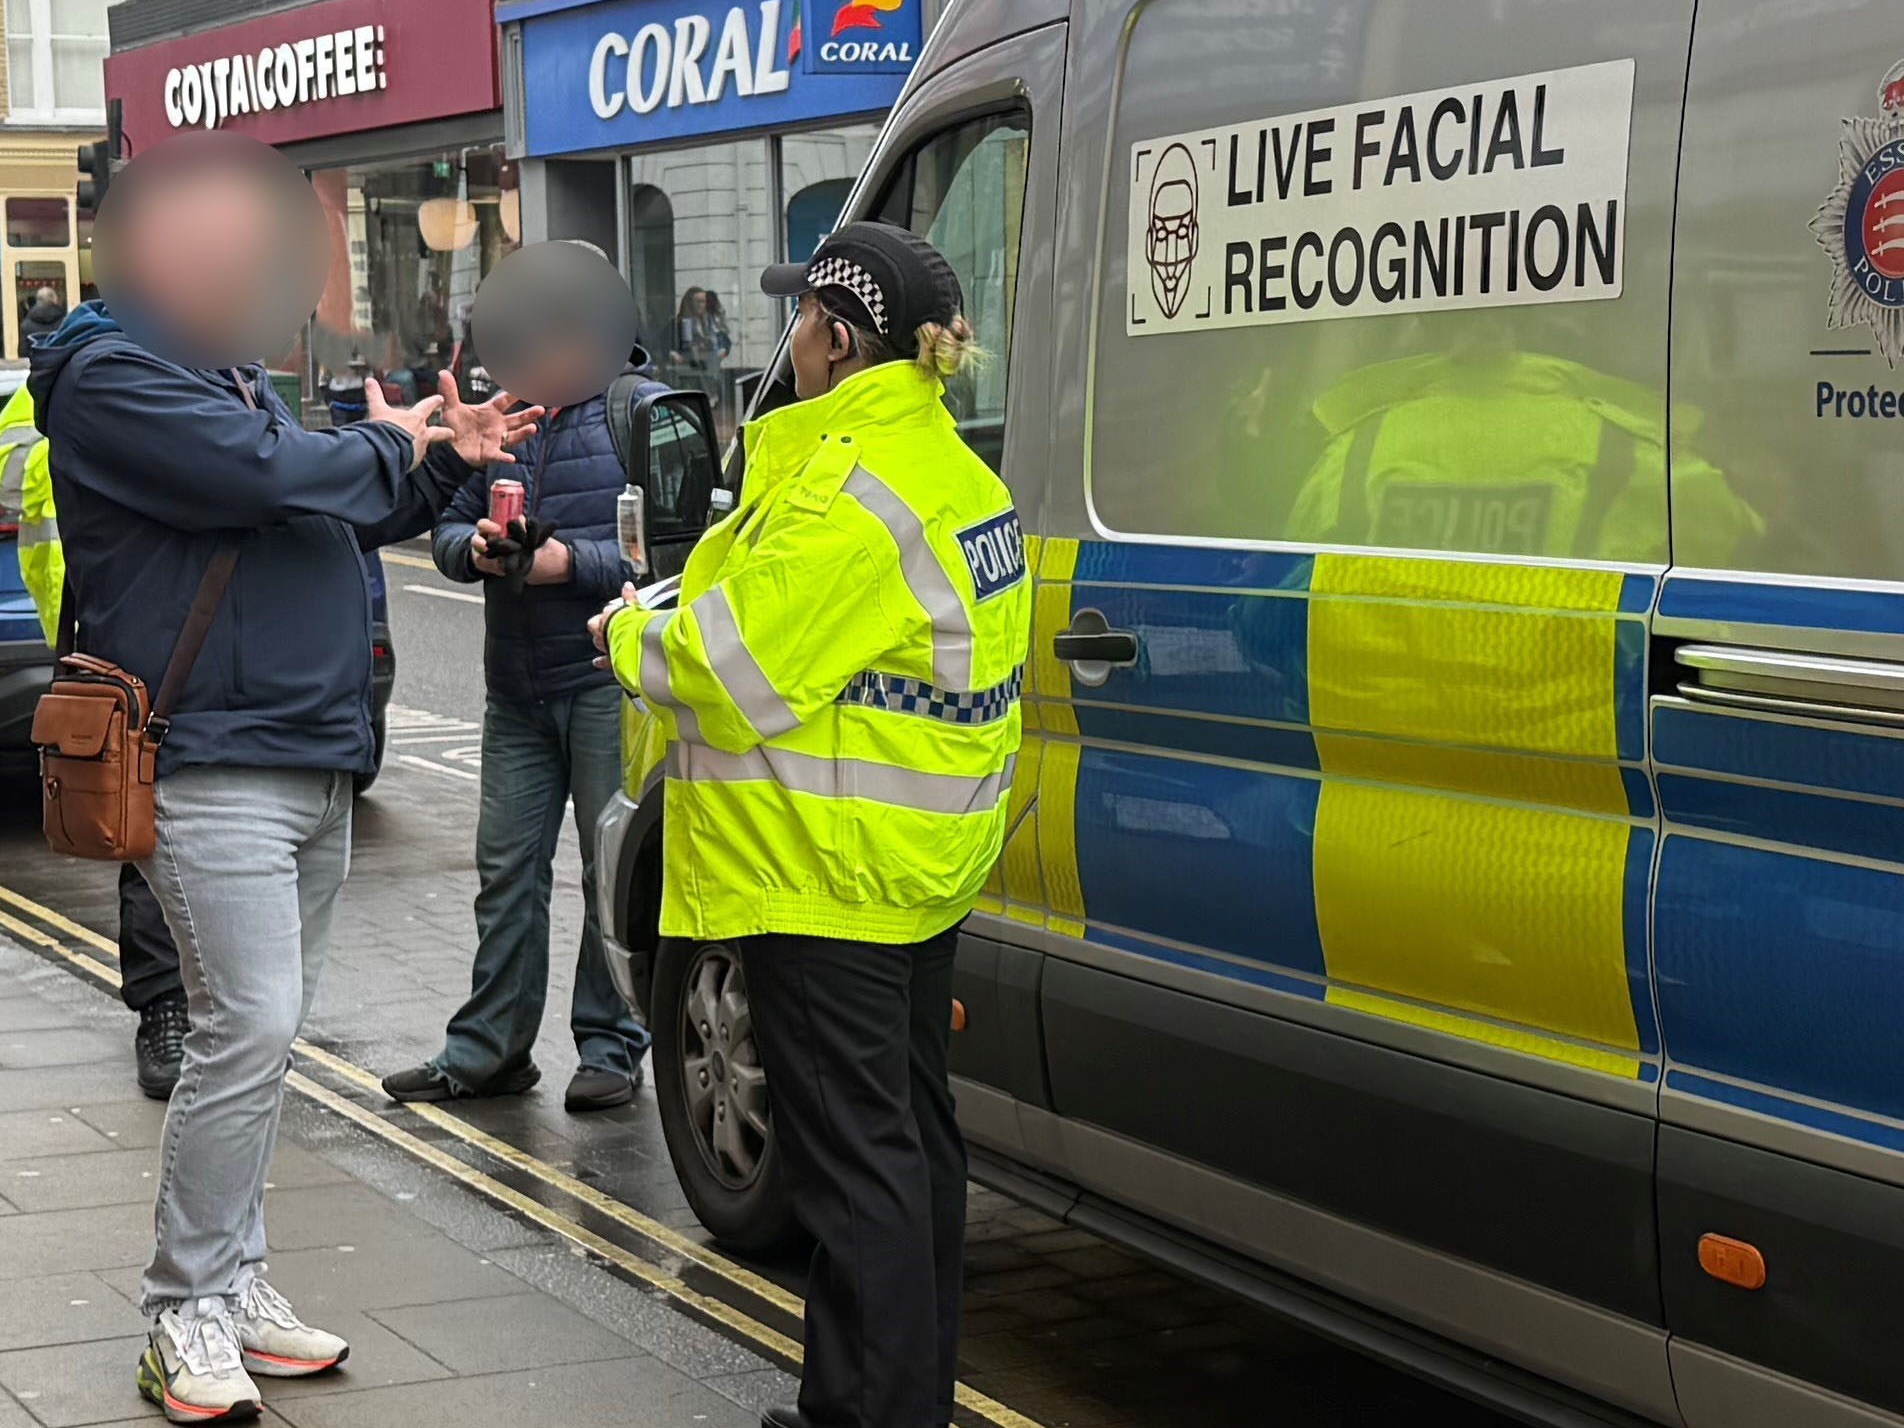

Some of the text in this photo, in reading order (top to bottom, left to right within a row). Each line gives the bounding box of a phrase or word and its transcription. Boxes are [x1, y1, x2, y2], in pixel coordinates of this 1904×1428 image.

[164, 25, 379, 129] COSTA COFFEE
[820, 41, 913, 63] CORAL
[1226, 84, 1565, 206] LIVE FACIAL
[1224, 199, 1617, 315] RECOGNITION
[963, 518, 1024, 589] POLICE
